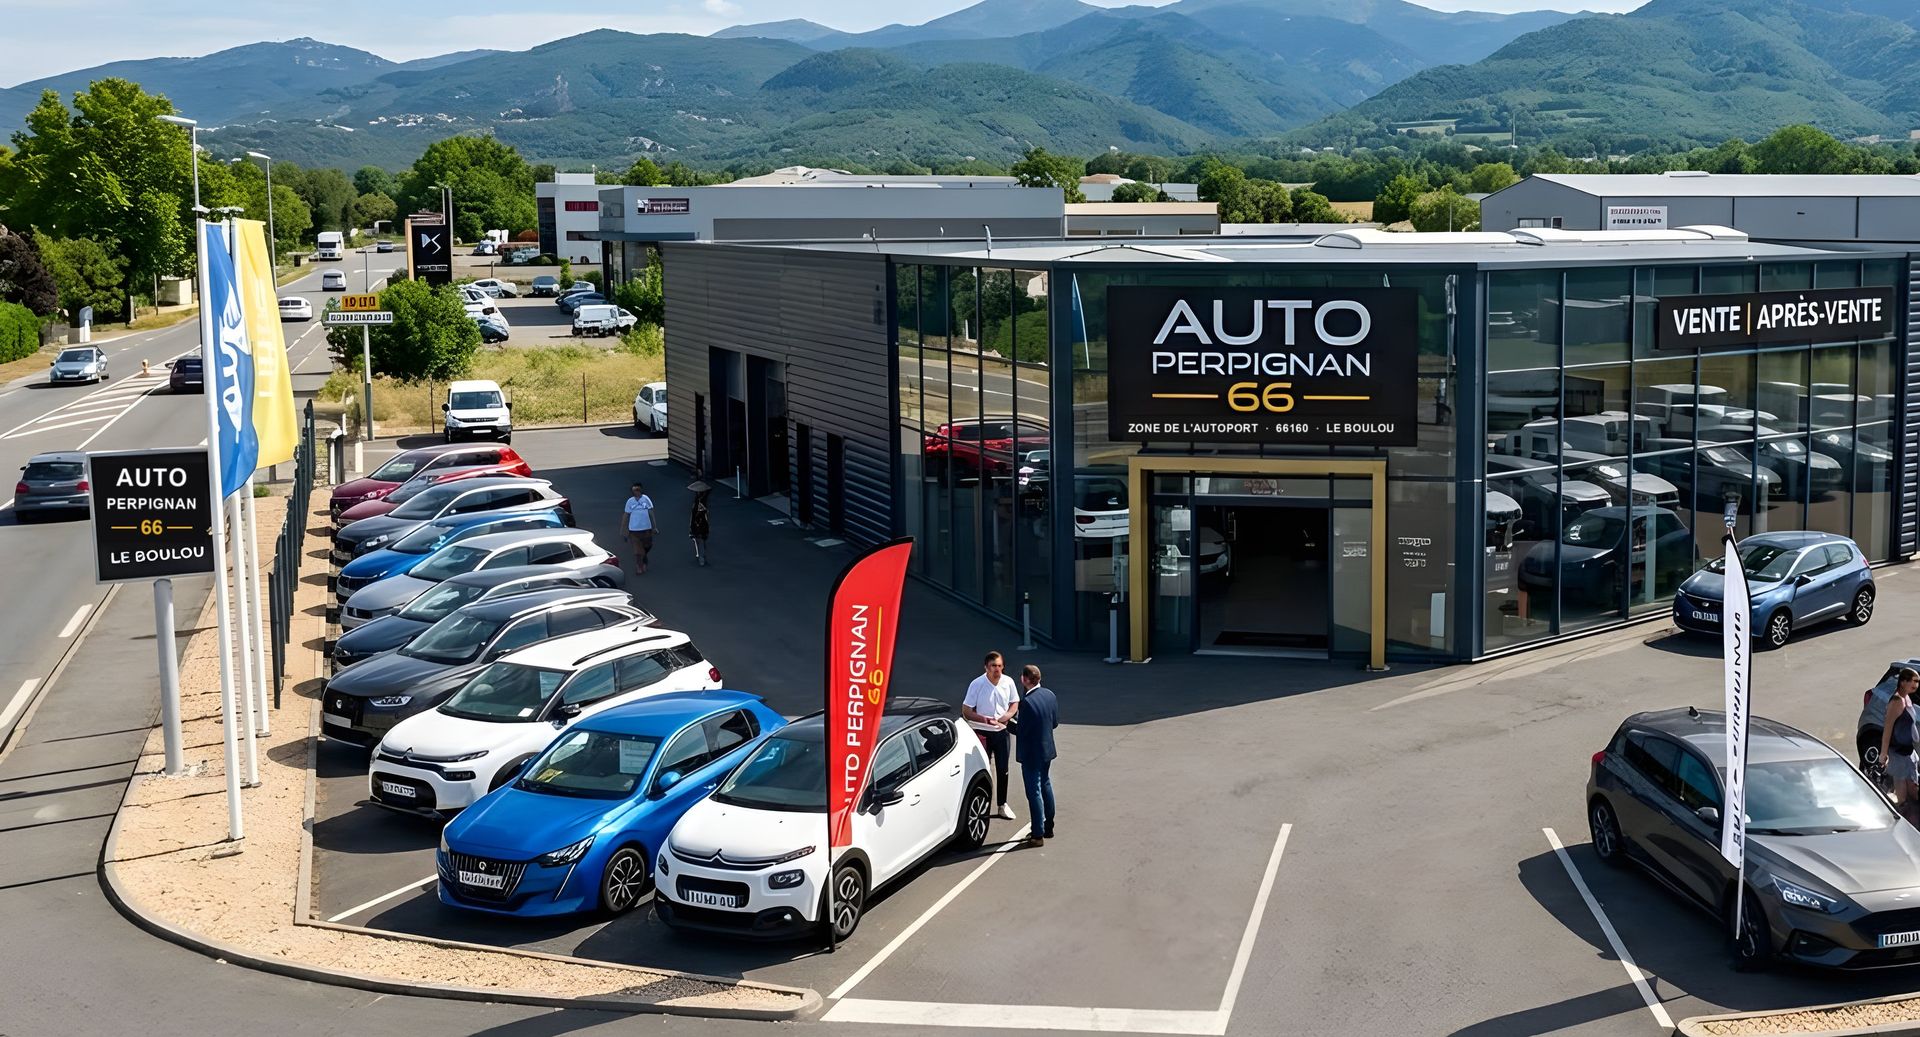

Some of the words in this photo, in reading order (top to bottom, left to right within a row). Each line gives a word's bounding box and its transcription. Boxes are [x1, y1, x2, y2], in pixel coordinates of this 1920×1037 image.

[1153, 299, 1371, 346] AUTO
[1673, 305, 1741, 336] VENTE
[1756, 295, 1882, 330] APRÈS-VENTE
[1152, 351, 1371, 377] PERPIGNAN
[1228, 381, 1294, 412] 66
[1128, 423, 1160, 433] ZONE
[1164, 423, 1179, 433] DE
[1183, 423, 1258, 433] L'AUTOPORT
[1275, 423, 1309, 433] 66160
[1326, 423, 1341, 433] LE
[1344, 423, 1394, 433] BOULOU
[116, 468, 187, 487] AUTO
[107, 498, 196, 510] PERPIGNAN
[141, 520, 163, 535] 66
[111, 551, 130, 564] LE
[135, 546, 204, 562] BOULOU
